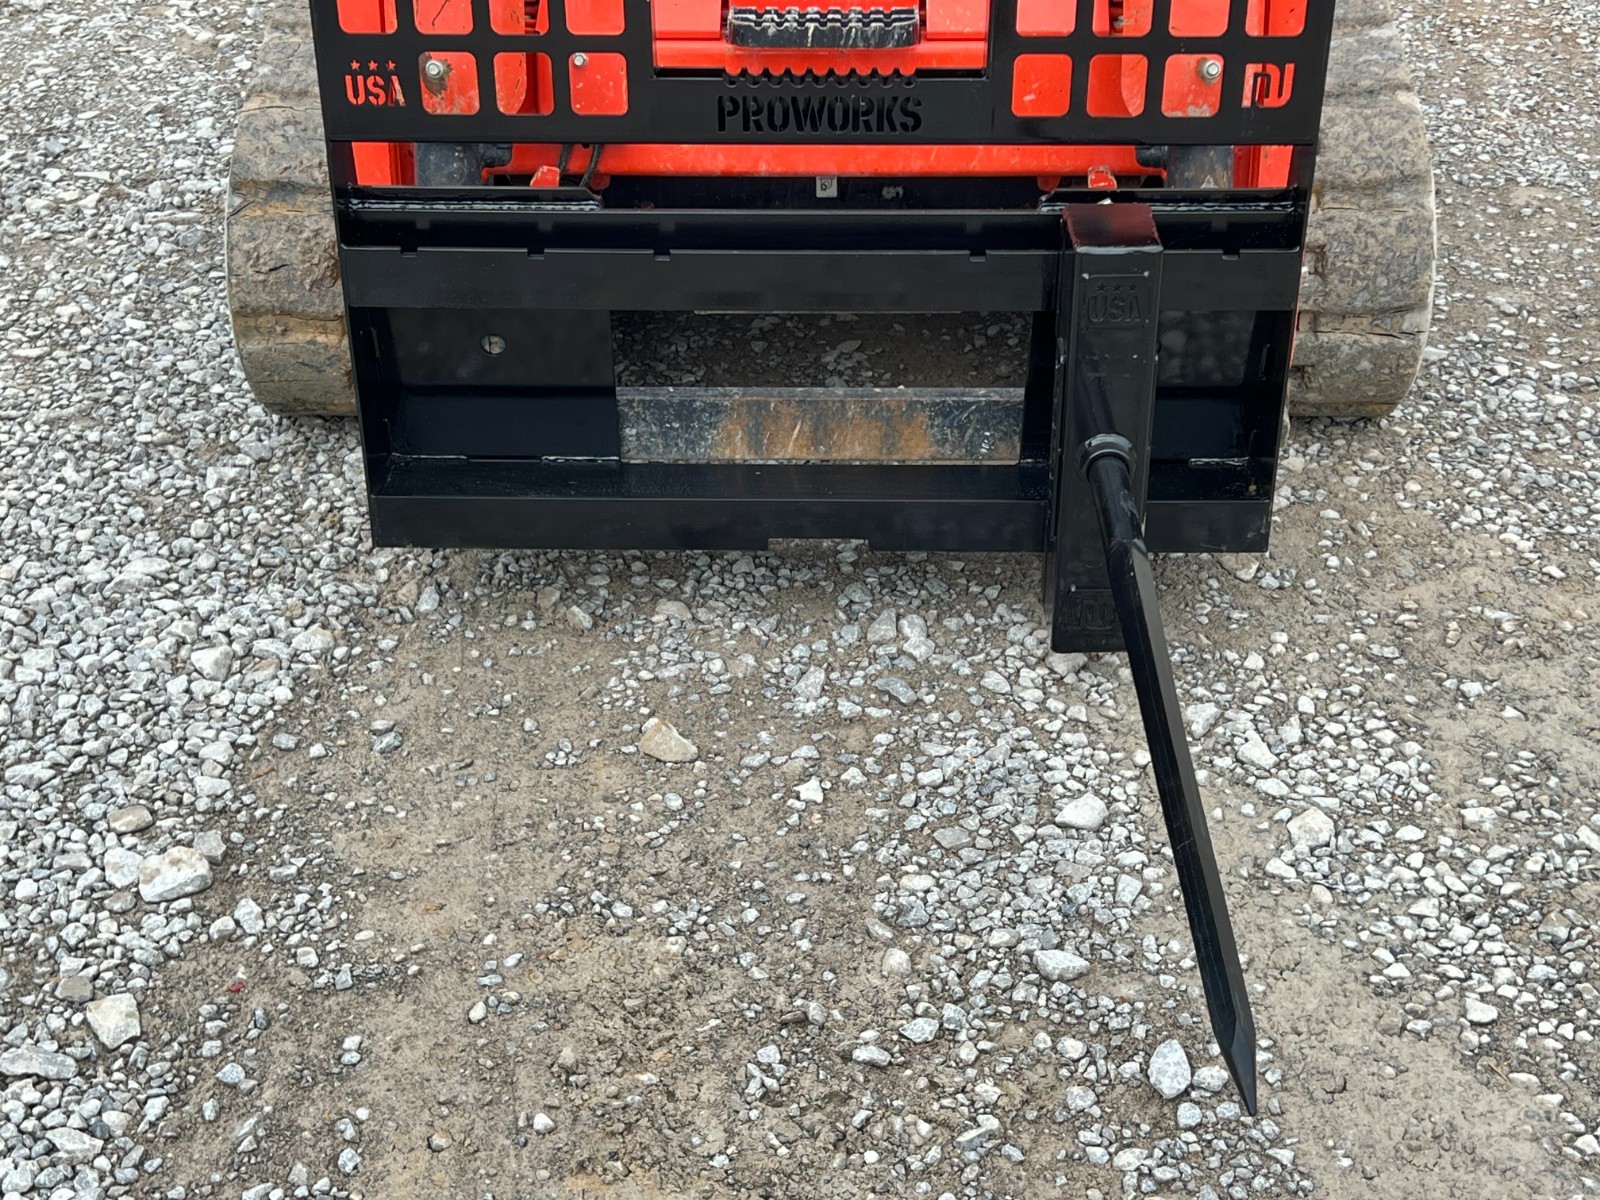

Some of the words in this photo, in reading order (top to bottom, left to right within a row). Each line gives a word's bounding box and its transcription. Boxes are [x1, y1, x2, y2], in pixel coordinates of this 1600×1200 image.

[344, 74, 406, 107] USA
[717, 95, 923, 133] PROWORKS
[1087, 295, 1142, 323] USA
